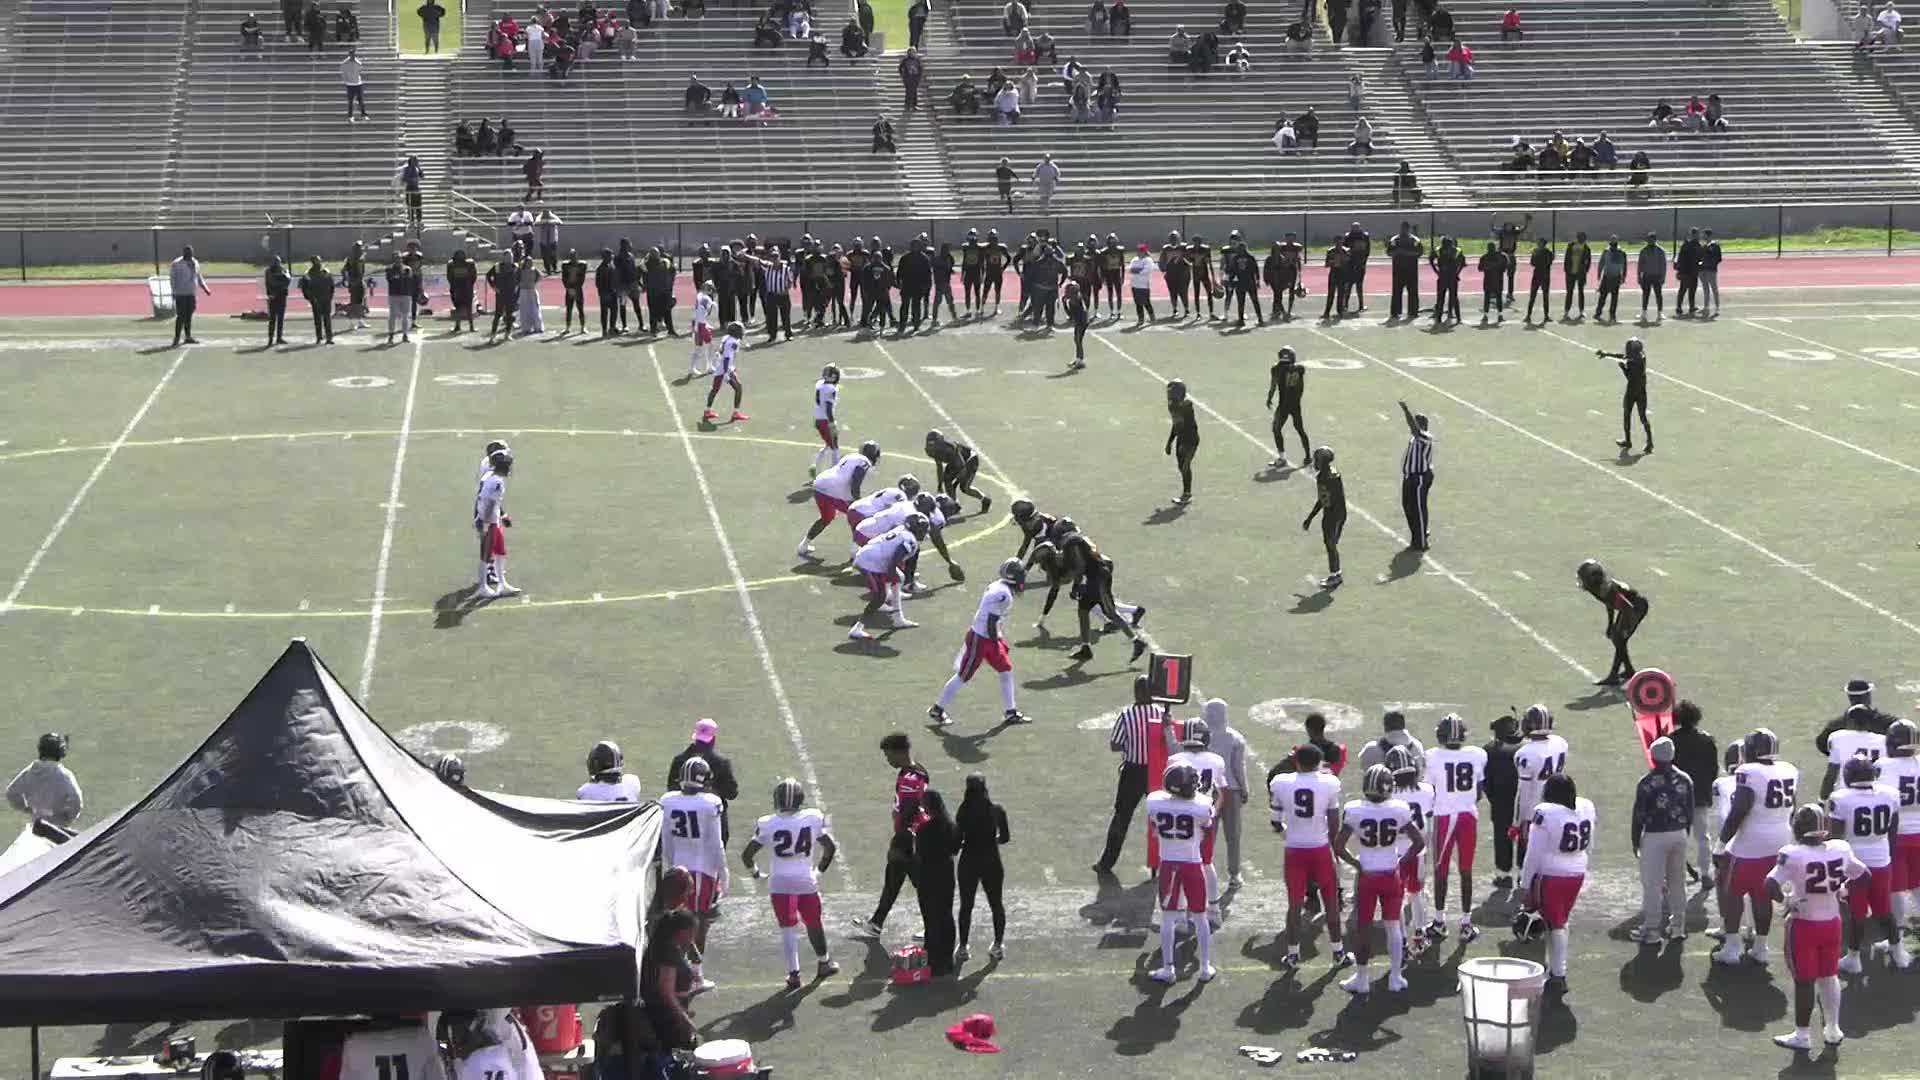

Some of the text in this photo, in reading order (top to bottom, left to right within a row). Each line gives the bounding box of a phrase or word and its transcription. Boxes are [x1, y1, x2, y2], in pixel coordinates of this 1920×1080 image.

[1161, 658, 1180, 696] 1
[1443, 761, 1475, 793] 18
[1293, 788, 1316, 818] 9
[1765, 778, 1795, 809] 65
[671, 810, 701, 839] 31
[1156, 812, 1195, 840] 29
[1360, 817, 1398, 848] 36
[1560, 819, 1592, 853] 68
[1854, 804, 1891, 837] 60
[773, 829, 812, 858] 24
[1805, 859, 1845, 894] 25
